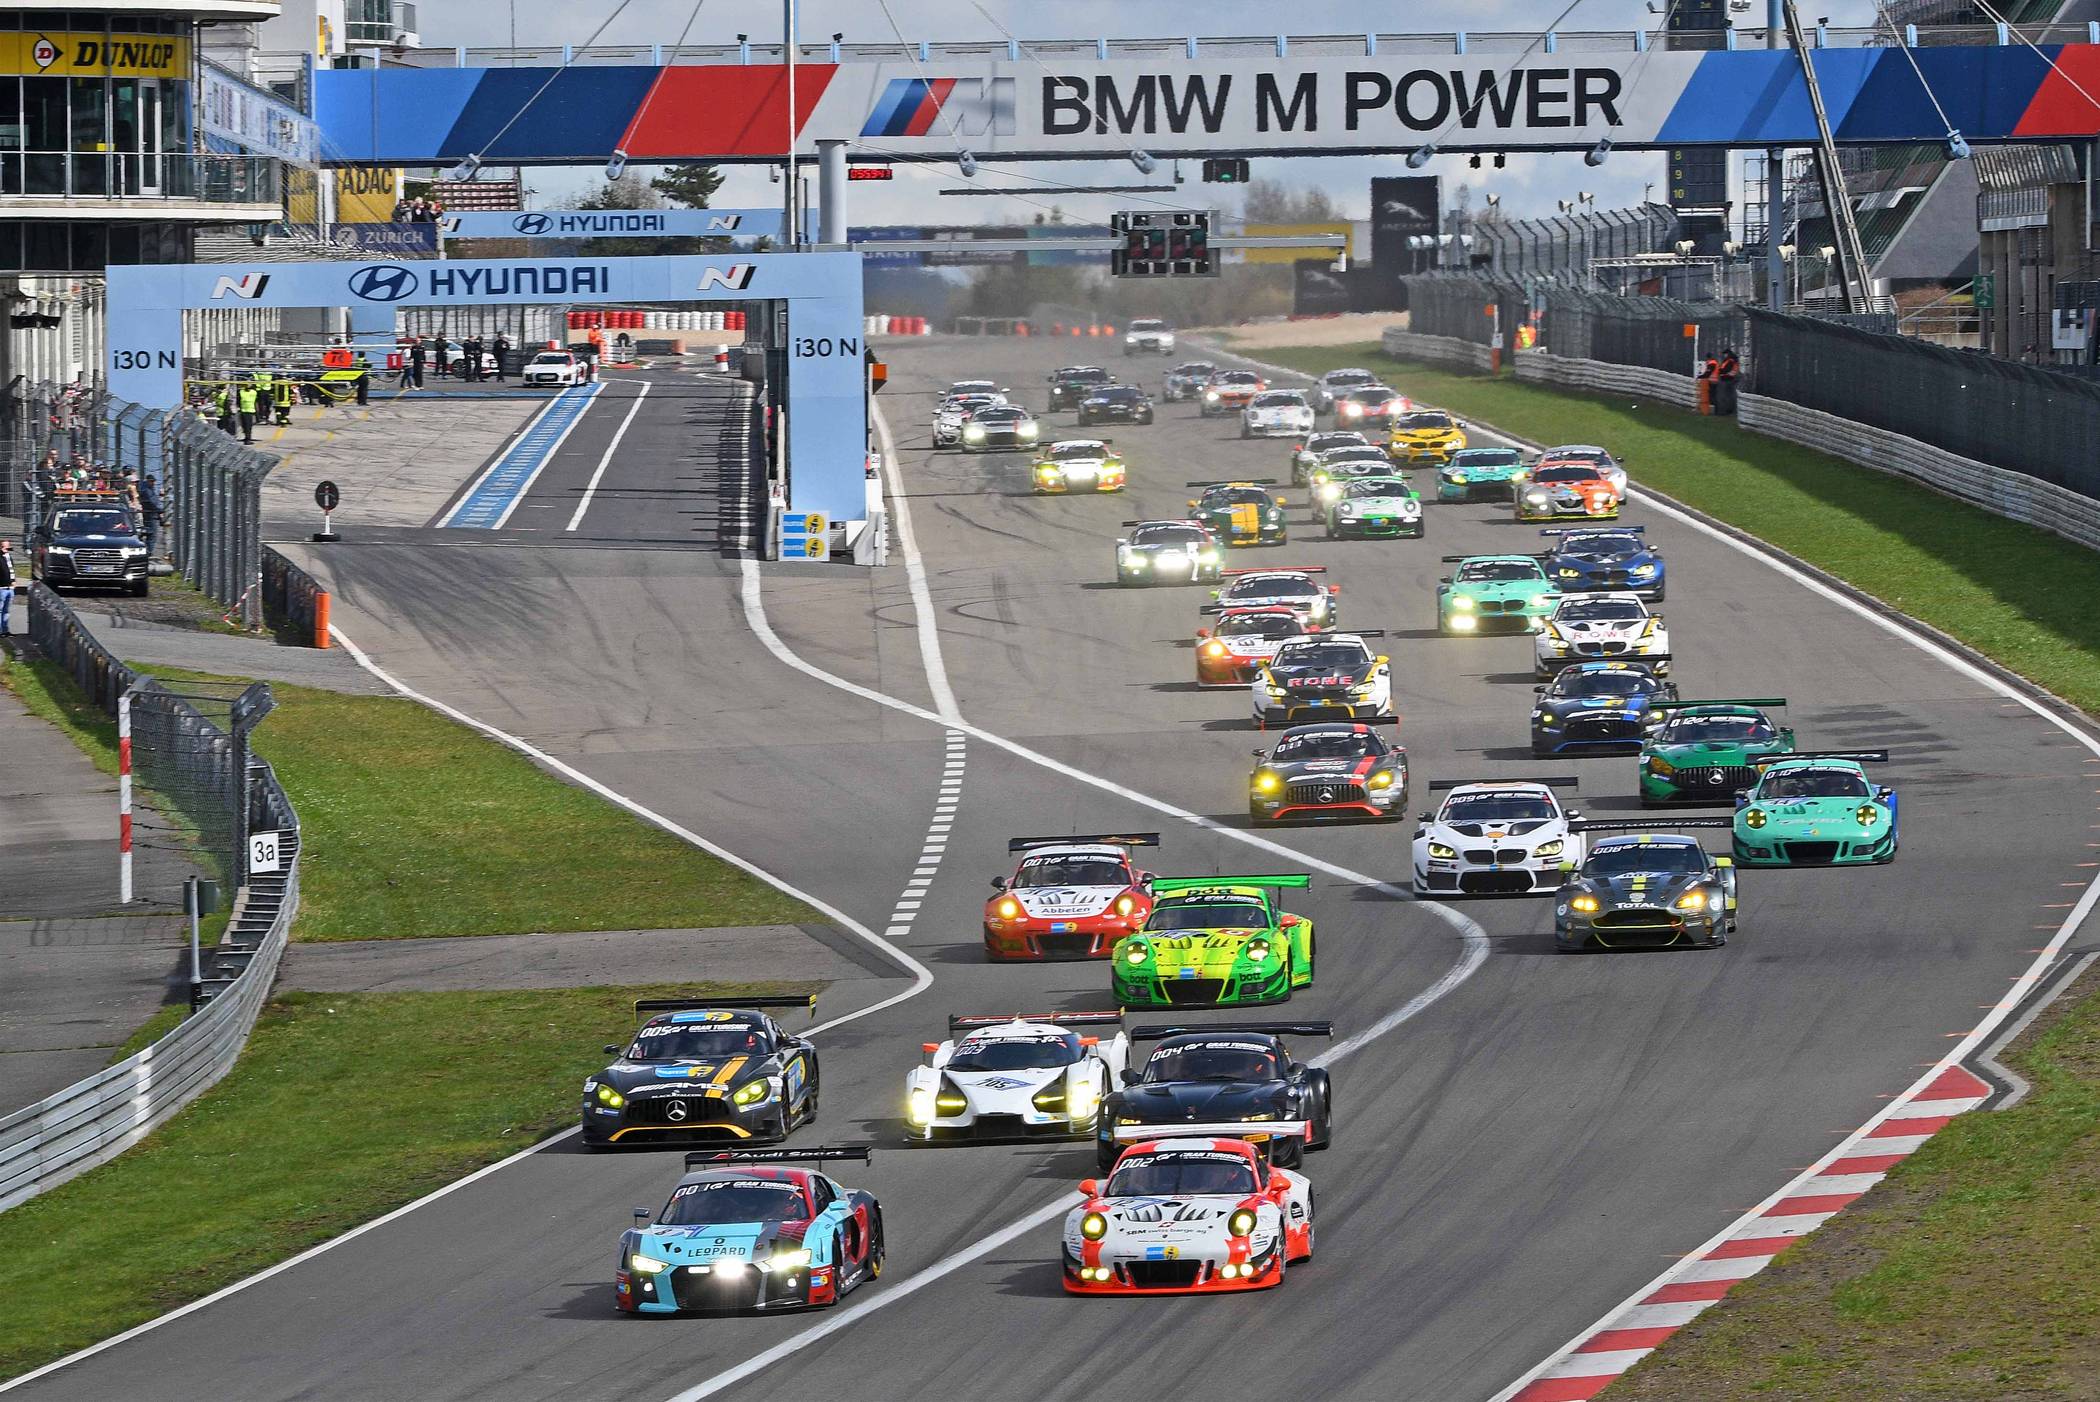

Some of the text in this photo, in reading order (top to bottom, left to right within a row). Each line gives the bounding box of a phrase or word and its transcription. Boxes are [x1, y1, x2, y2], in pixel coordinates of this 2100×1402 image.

[73, 41, 174, 68] DUNLOP
[1042, 67, 1624, 135] BMW M POWER
[1674, 150, 1682, 161] 8
[342, 167, 393, 195] ADAC
[1674, 169, 1683, 180] 9
[1673, 188, 1685, 199] 10
[560, 214, 665, 232] HYUNDAI
[430, 266, 609, 296] HYUNDAI
[795, 336, 857, 358] i30 N
[113, 350, 176, 370] i30 N
[253, 840, 275, 863] 3a
[1041, 906, 1091, 914] Abbelen
[1239, 972, 1261, 982] bott
[1150, 1046, 1184, 1062] 004
[976, 1078, 1007, 1089] 705
[738, 1149, 844, 1159] Audi Sport
[1119, 1158, 1155, 1170] 002
[1206, 1152, 1249, 1162] TURISMO
[760, 1181, 804, 1190] TURISMO
[688, 1246, 746, 1257] LEOPARD
